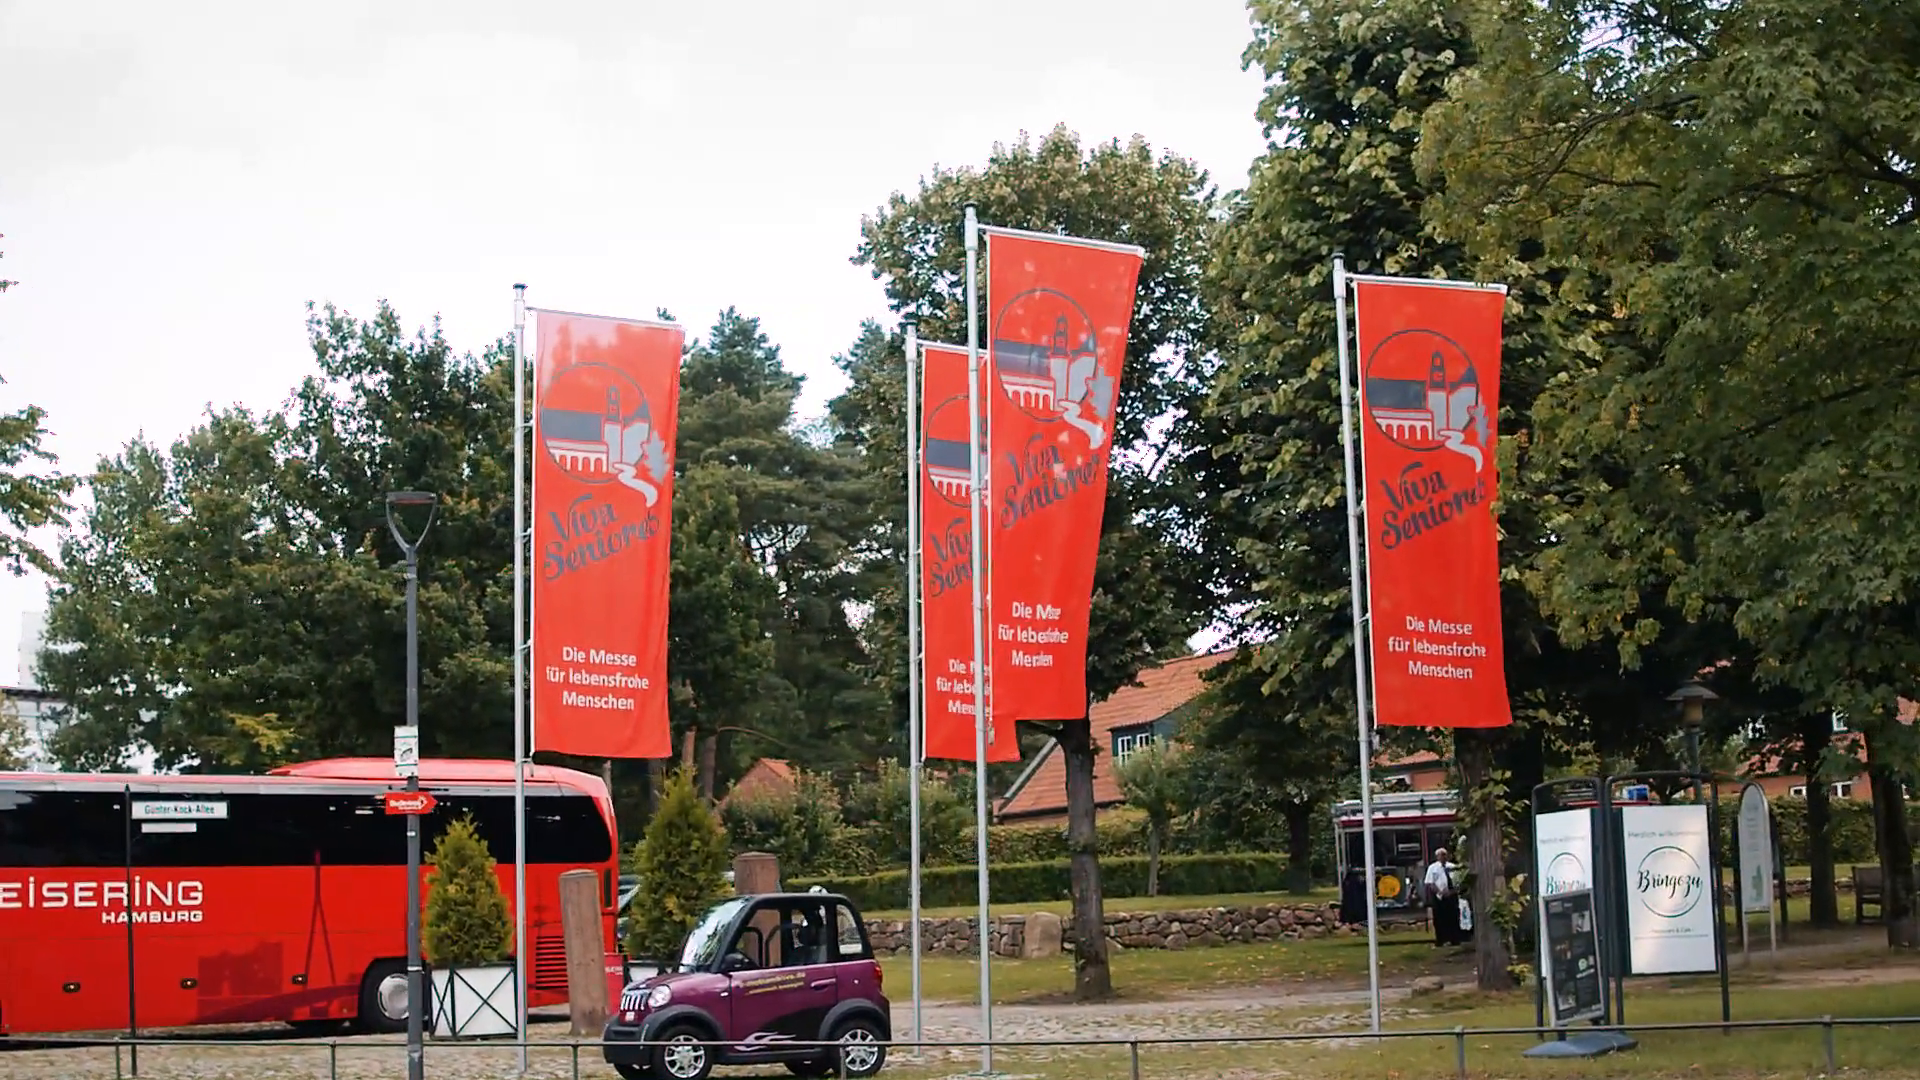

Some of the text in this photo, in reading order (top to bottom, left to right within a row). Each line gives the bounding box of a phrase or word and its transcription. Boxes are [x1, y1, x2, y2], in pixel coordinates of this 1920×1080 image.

[1380, 461, 1447, 510] Viva
[549, 493, 619, 542] Viva
[1012, 601, 1032, 619] Die
[998, 623, 1015, 641] für
[1406, 615, 1473, 636] Die Messe
[562, 645, 637, 667] Die Messe
[1388, 636, 1487, 658] für lebensfrohe
[948, 658, 967, 675] Die
[1408, 659, 1473, 679] Menschen
[546, 665, 650, 690] für lebensfrohe
[936, 676, 952, 693] für
[562, 690, 635, 711] Menschen
[101, 910, 203, 925] HAMBURG
